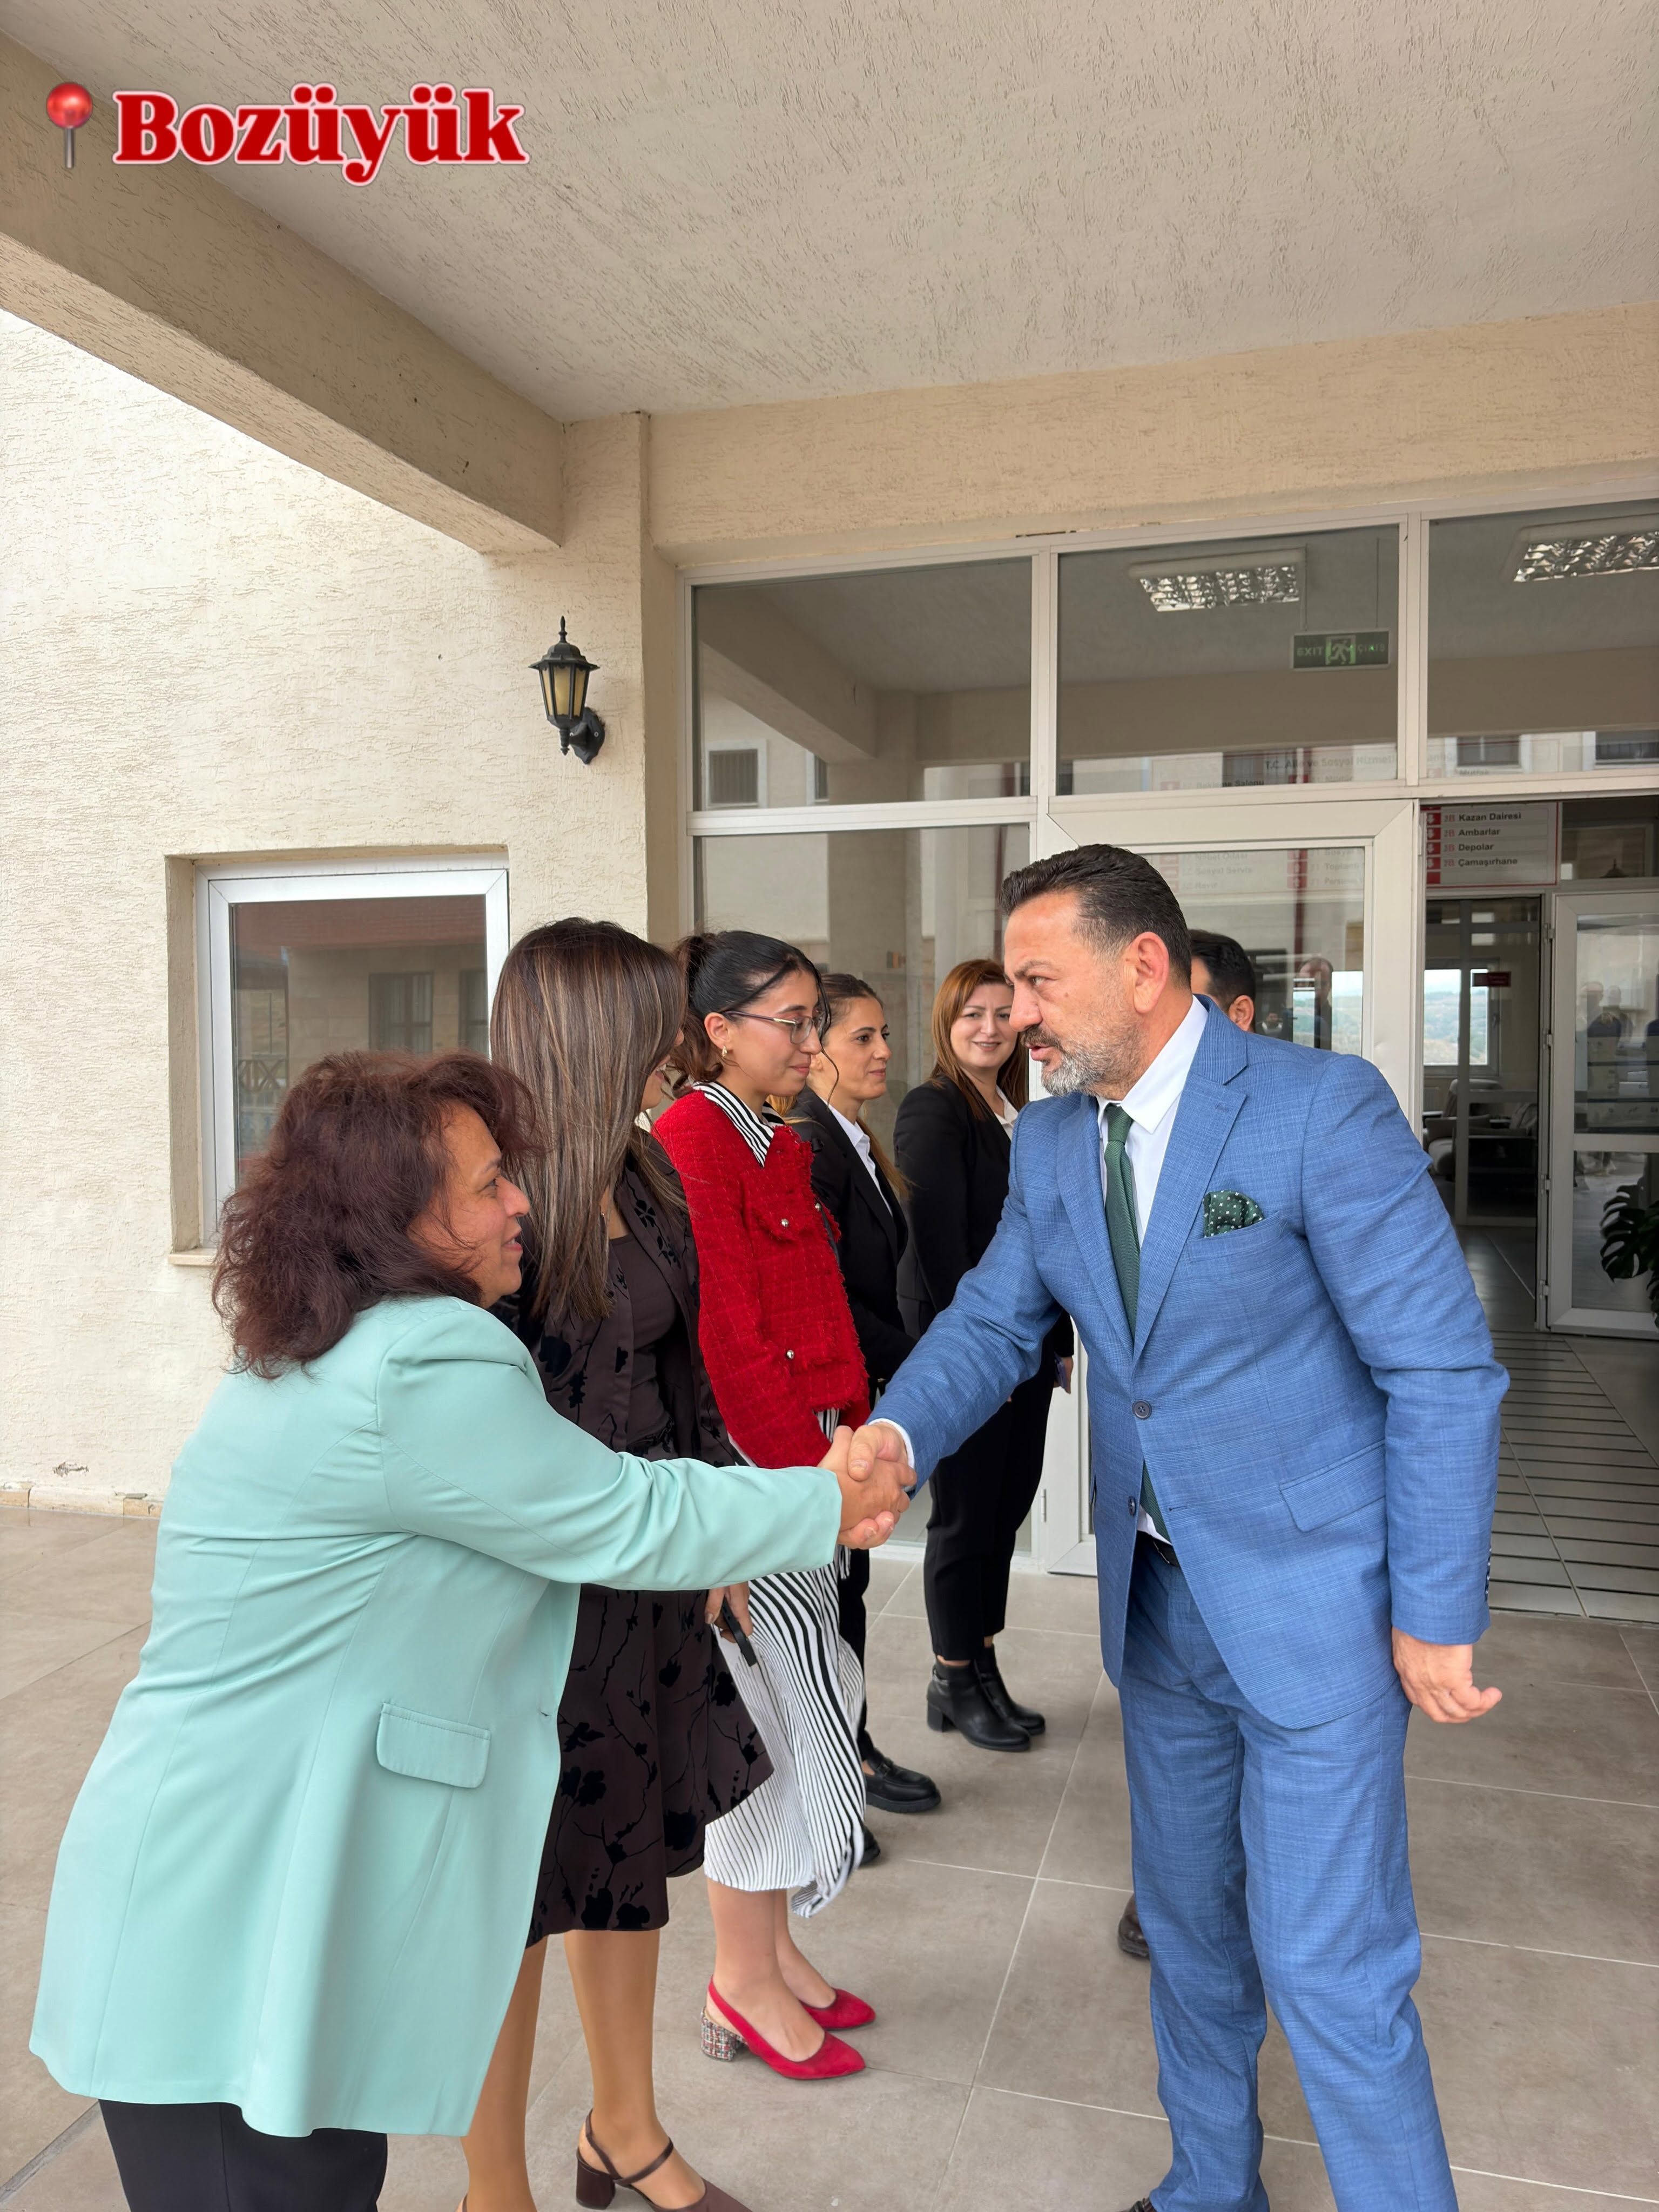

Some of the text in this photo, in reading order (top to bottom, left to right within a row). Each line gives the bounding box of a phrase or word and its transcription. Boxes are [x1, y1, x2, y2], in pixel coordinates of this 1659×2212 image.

[1297, 646, 1323, 657] EXIT
[1489, 812, 1521, 820] Dairesi
[1458, 828, 1501, 836] Ambarlar
[1458, 844, 1494, 852] Depolar
[1458, 858, 1518, 867] Çamaşırhane
